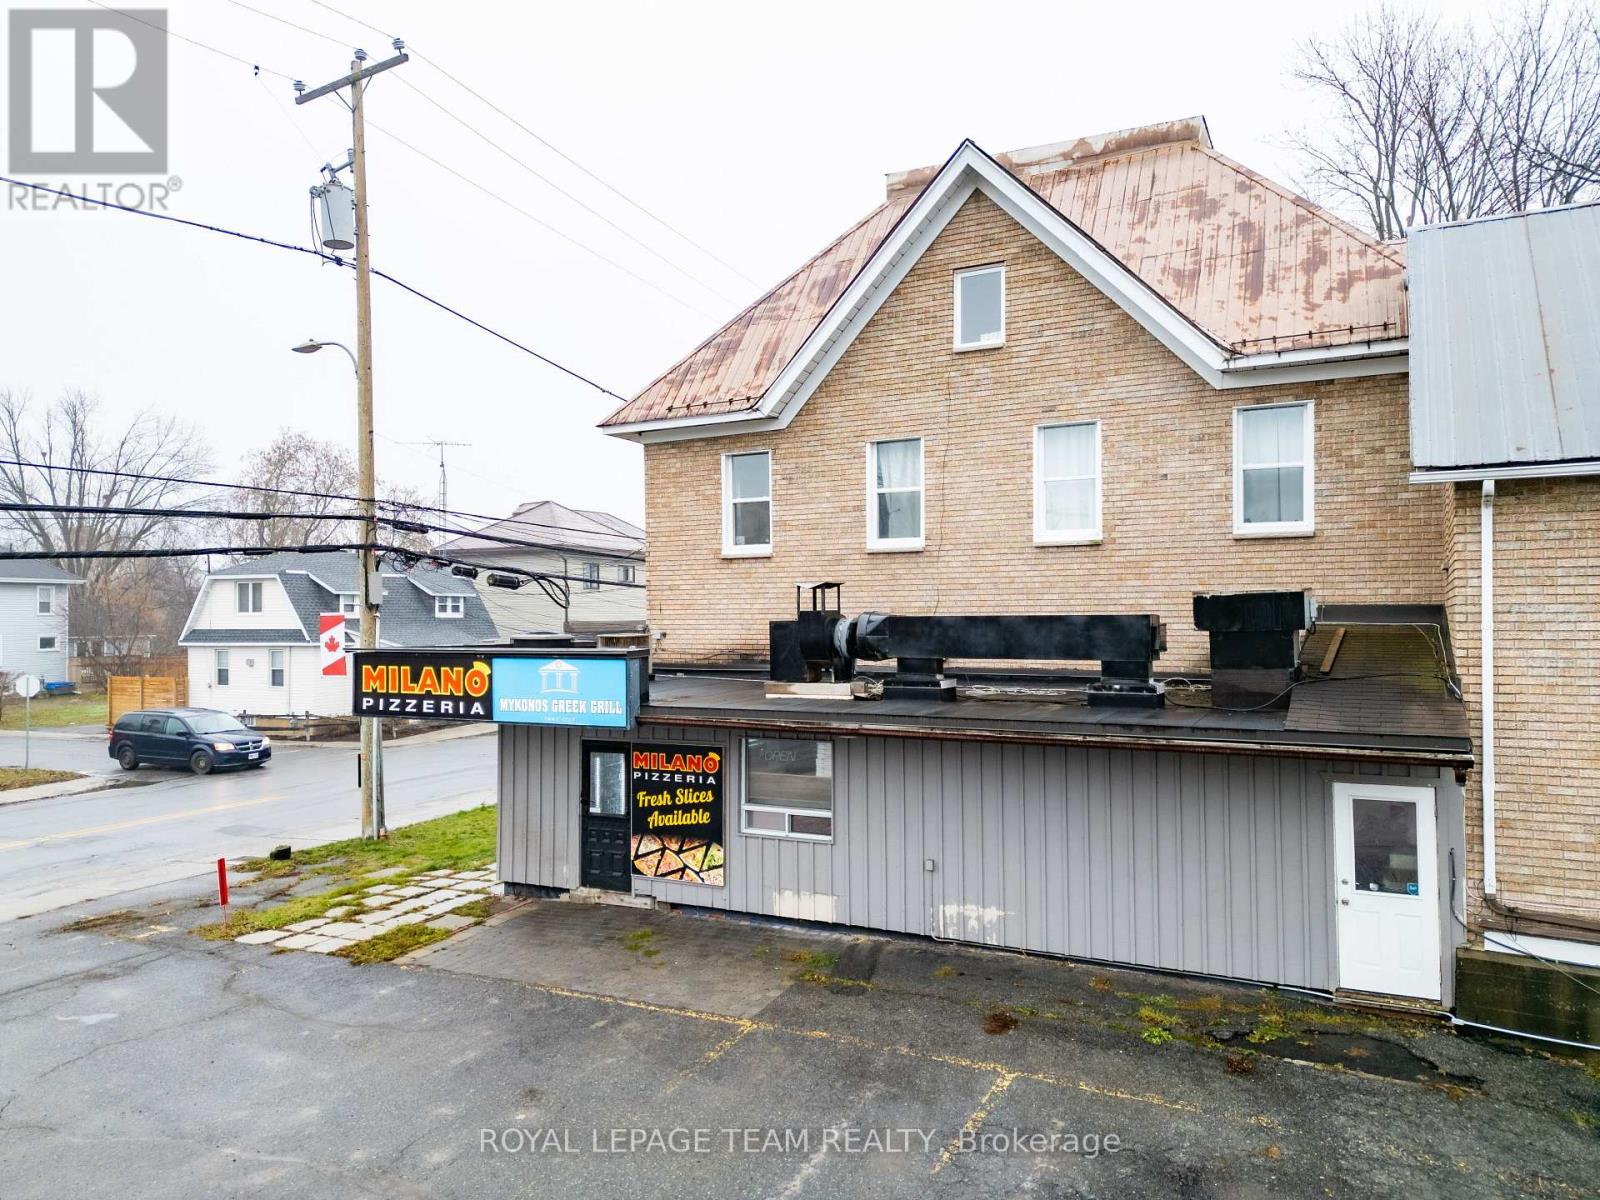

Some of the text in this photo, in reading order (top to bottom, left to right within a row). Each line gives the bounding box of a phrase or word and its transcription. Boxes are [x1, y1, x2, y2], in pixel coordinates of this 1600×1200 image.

[362, 661, 491, 697] MILANO
[362, 698, 485, 715] PIZZERIA
[499, 697, 623, 715] MYKONOS GREEK GRILL
[633, 752, 721, 774] MILANO
[764, 750, 798, 761] OPEN
[633, 771, 717, 785] PIZZERIA
[637, 788, 714, 807] Fresh Slices
[647, 808, 712, 829] Available
